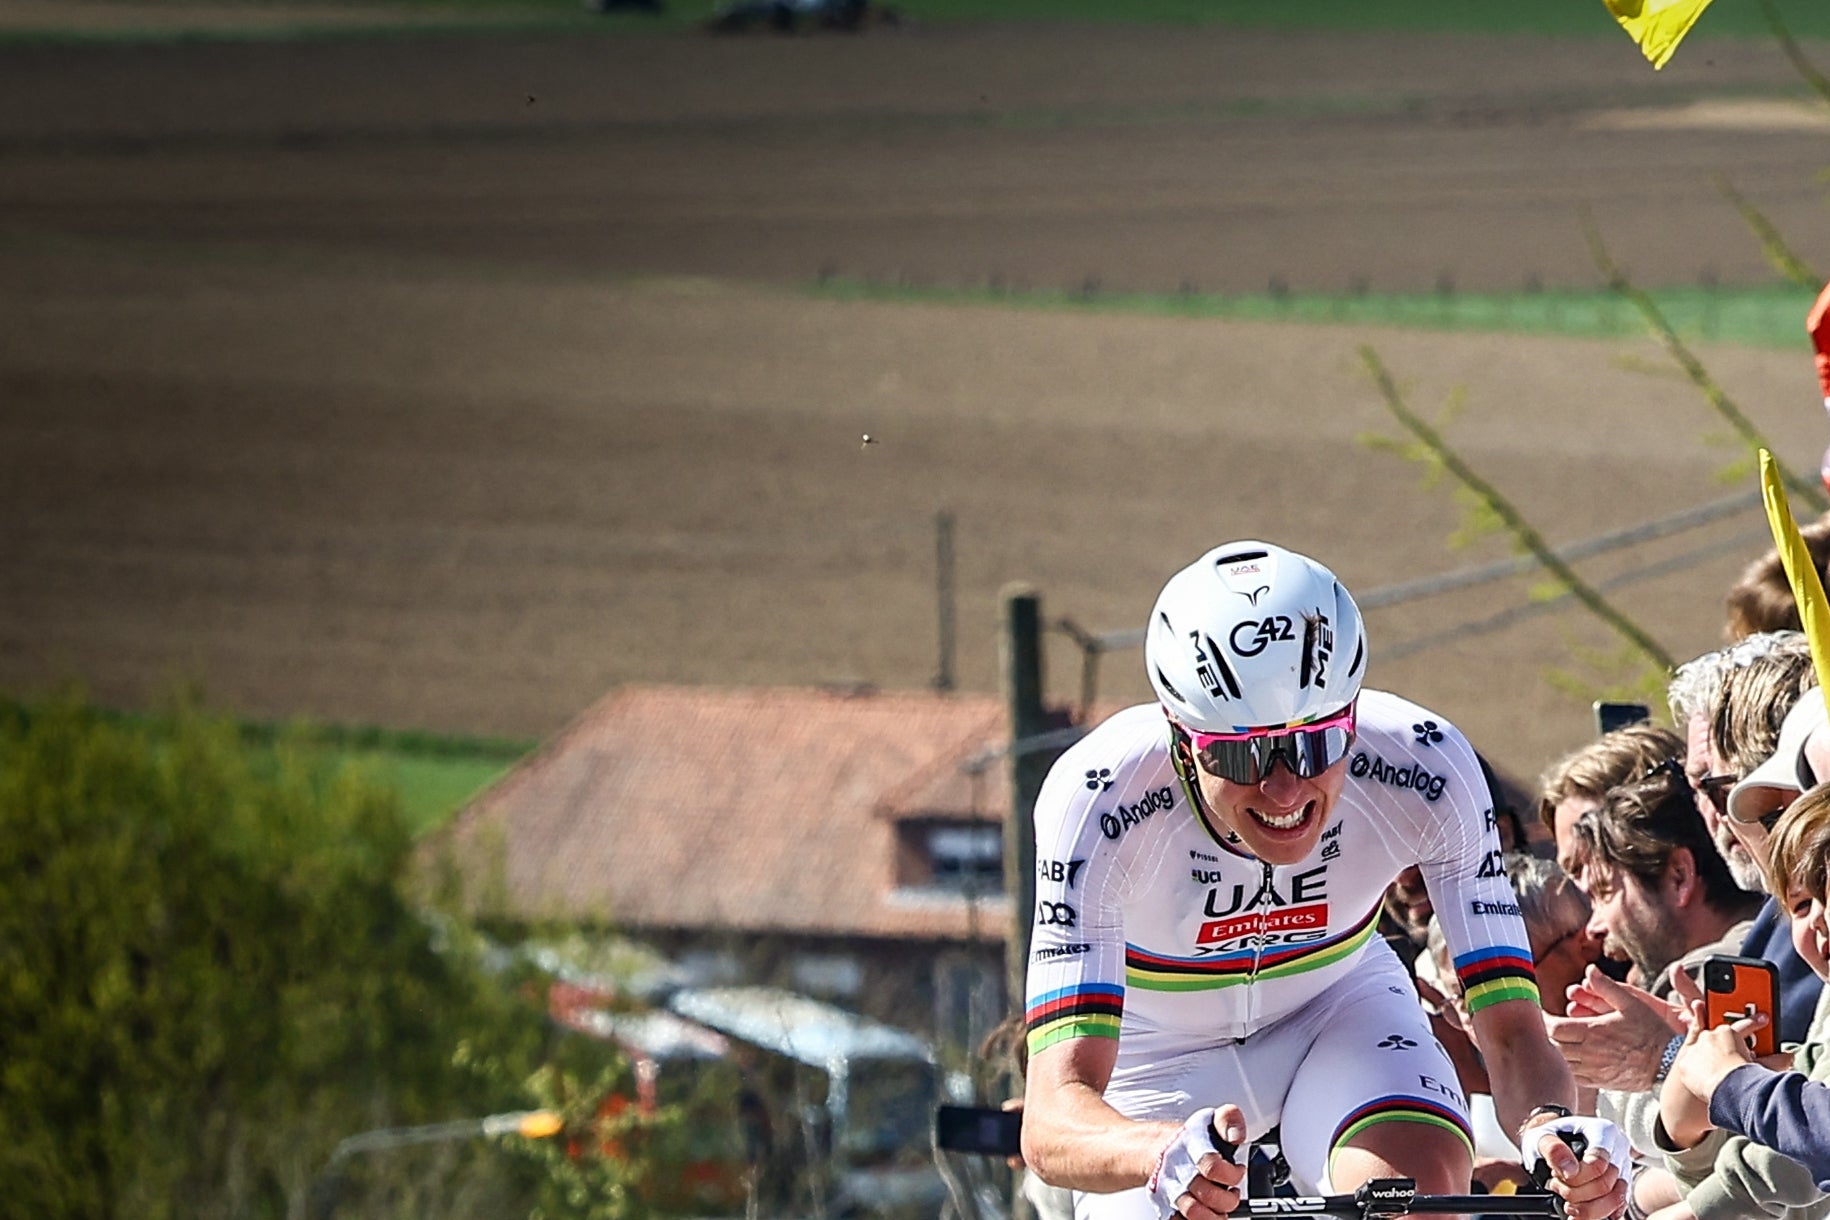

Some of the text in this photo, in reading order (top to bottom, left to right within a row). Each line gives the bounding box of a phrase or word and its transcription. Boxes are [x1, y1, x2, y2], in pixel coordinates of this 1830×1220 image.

[1229, 616, 1296, 657] G42
[1314, 606, 1333, 689] MET
[1189, 630, 1229, 701] MET
[1369, 755, 1447, 801] Analog
[1118, 786, 1174, 831] Analog
[1198, 869, 1222, 884] UCI
[1203, 865, 1328, 918] UAE
[1193, 928, 1328, 957] XRG
[1212, 912, 1317, 938] Emirates
[1372, 1187, 1415, 1199] wahoo
